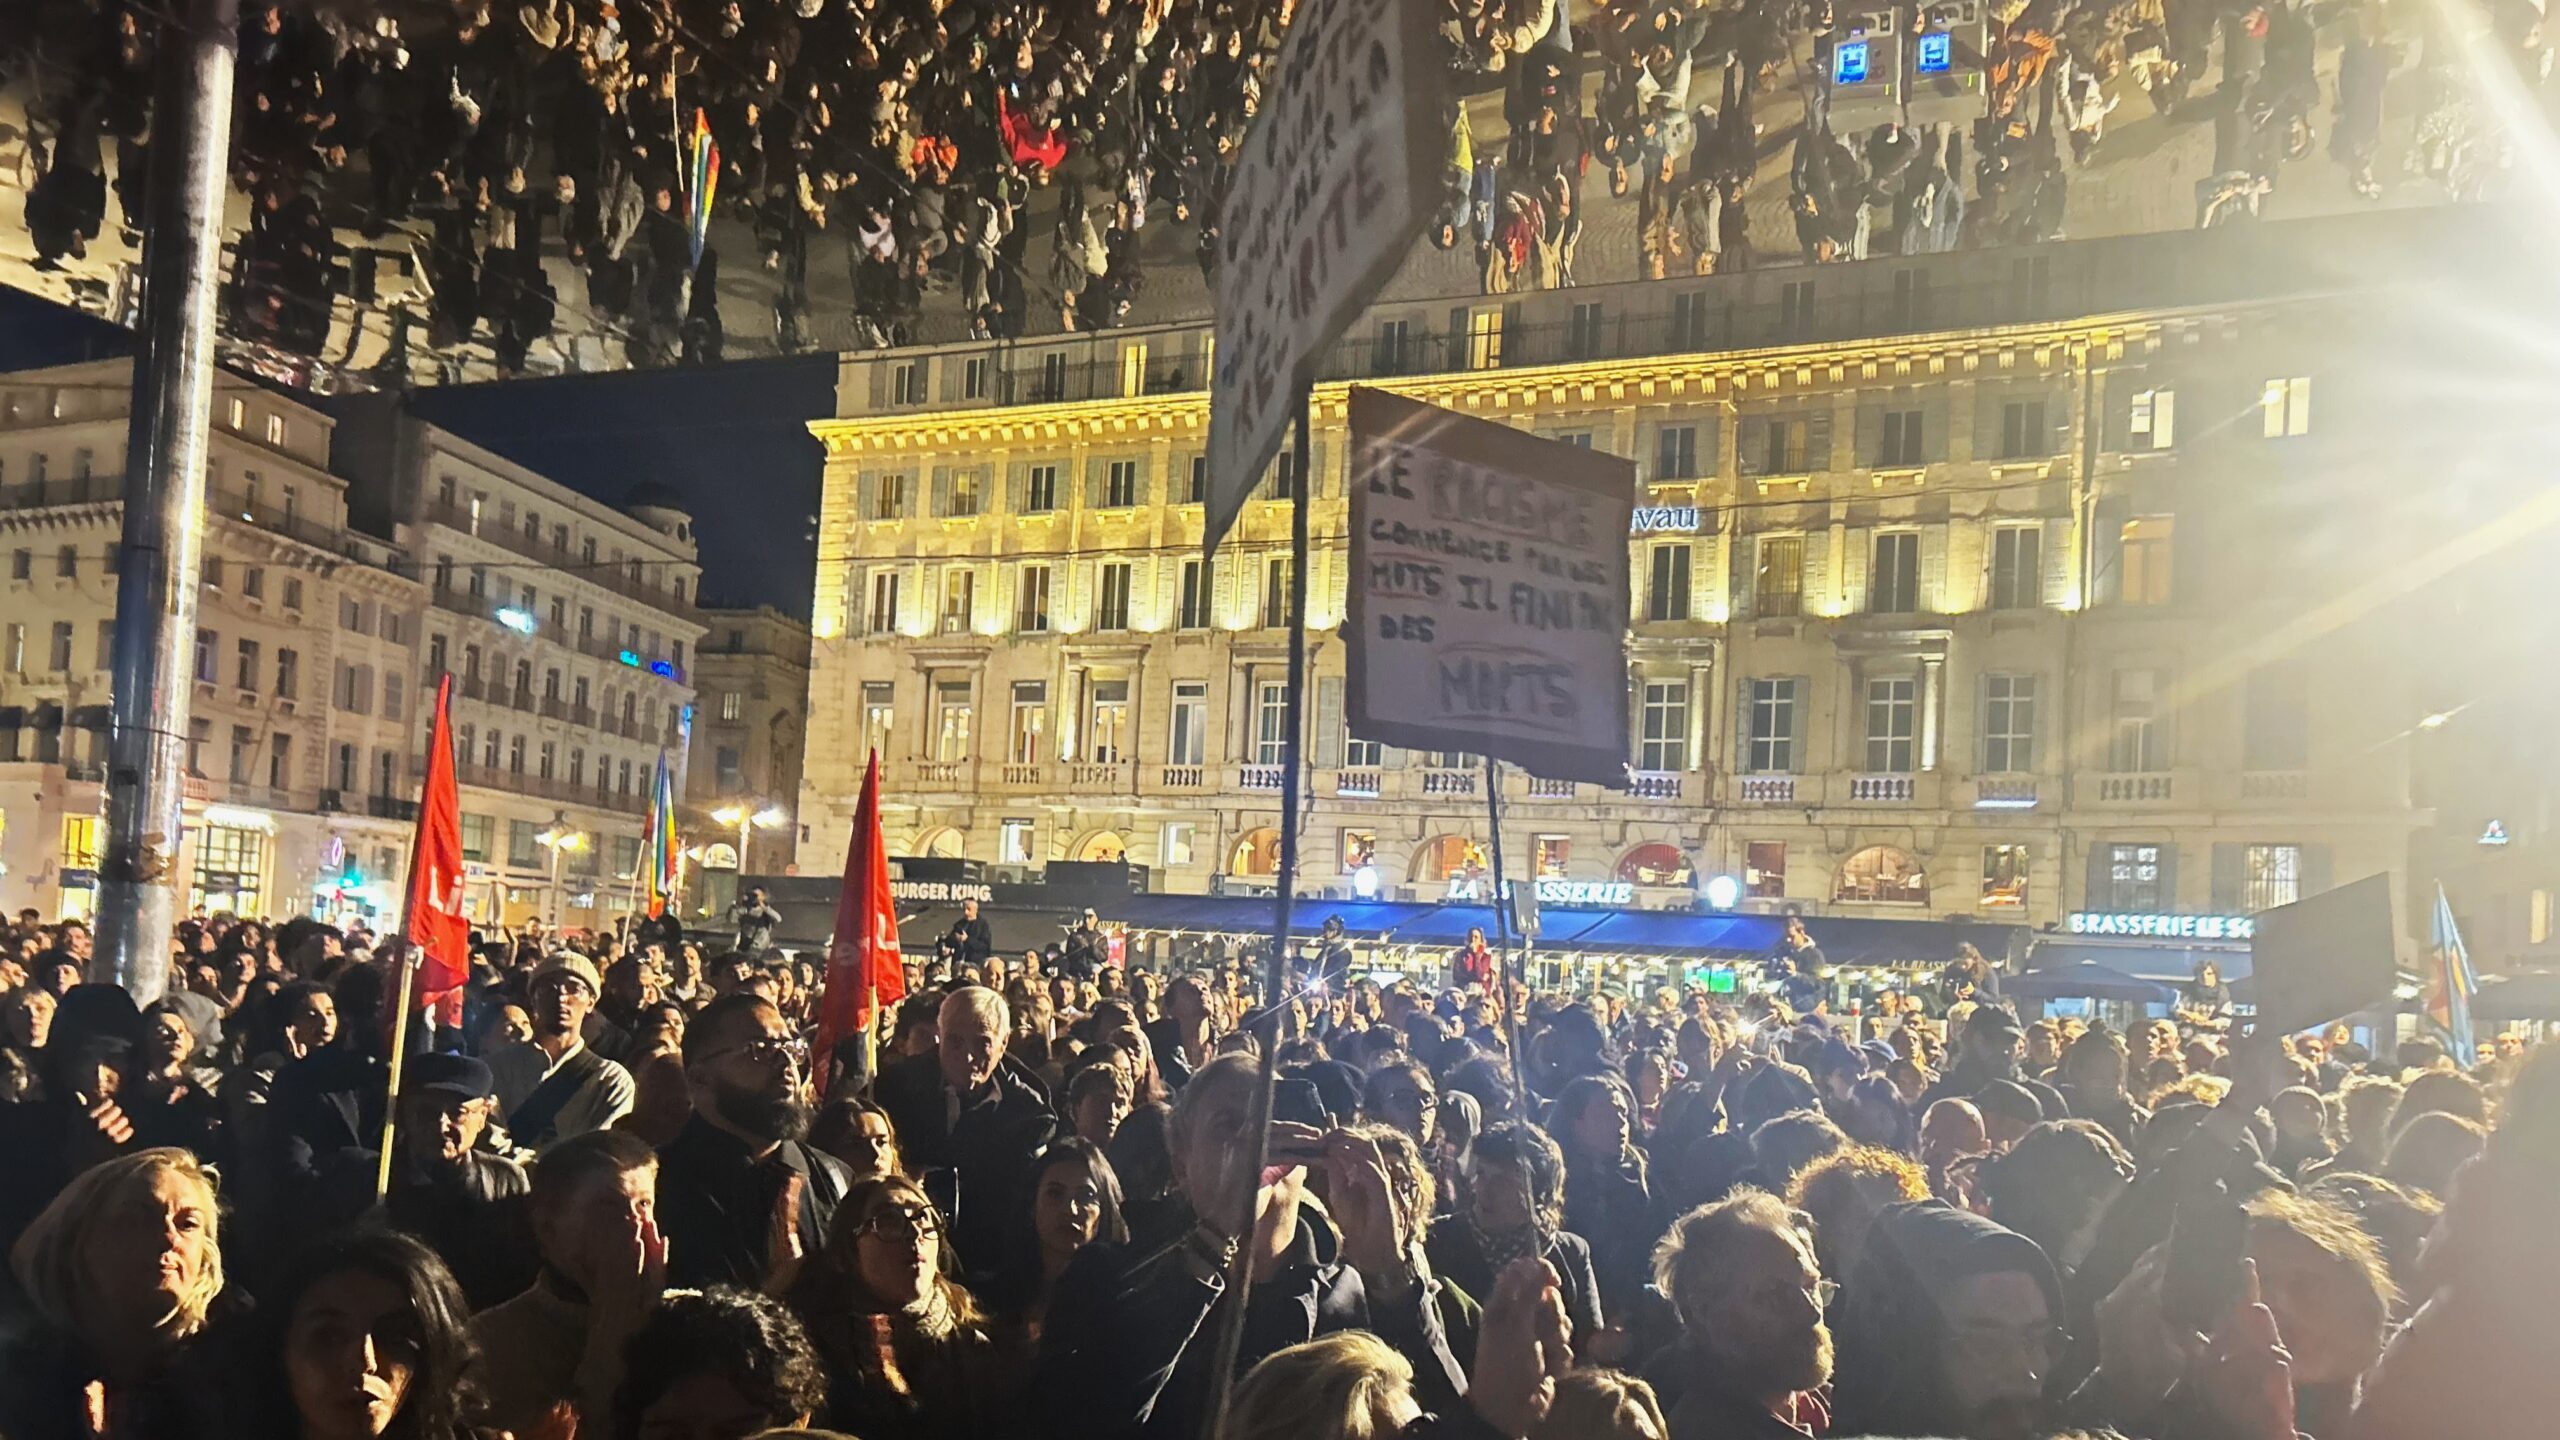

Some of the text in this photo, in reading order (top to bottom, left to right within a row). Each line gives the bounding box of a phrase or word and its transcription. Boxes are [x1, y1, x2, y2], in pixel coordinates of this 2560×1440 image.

[1369, 446, 1415, 500] LE
[890, 881, 990, 902] BURGER KING
[1448, 879, 1478, 899] LA
[2069, 914, 2194, 936] BRASSERIE
